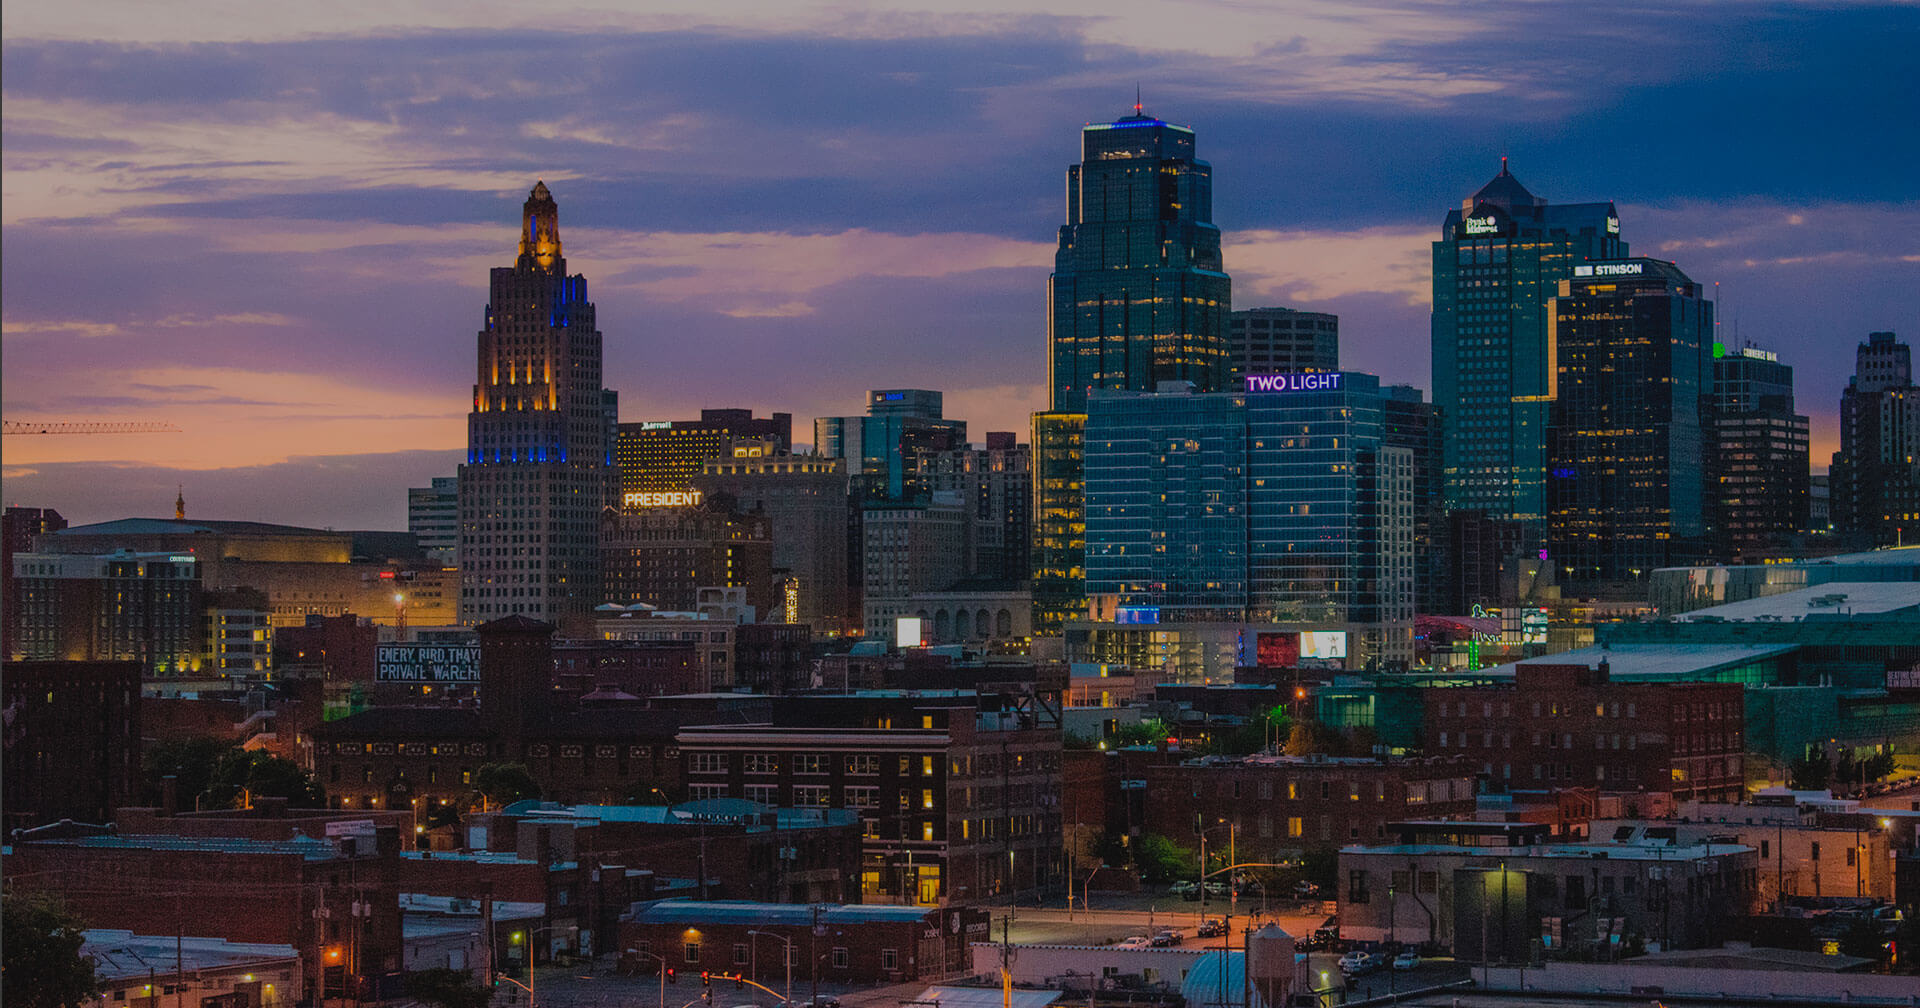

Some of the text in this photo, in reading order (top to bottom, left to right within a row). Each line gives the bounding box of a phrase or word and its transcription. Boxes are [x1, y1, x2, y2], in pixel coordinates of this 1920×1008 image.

[1595, 264, 1643, 276] STINSON
[1246, 373, 1341, 392] TWO LIGHT
[623, 490, 702, 507] PRESIDENT
[378, 647, 415, 663] EMERY
[418, 647, 445, 663] BIRD
[379, 664, 427, 680] PRIVATE
